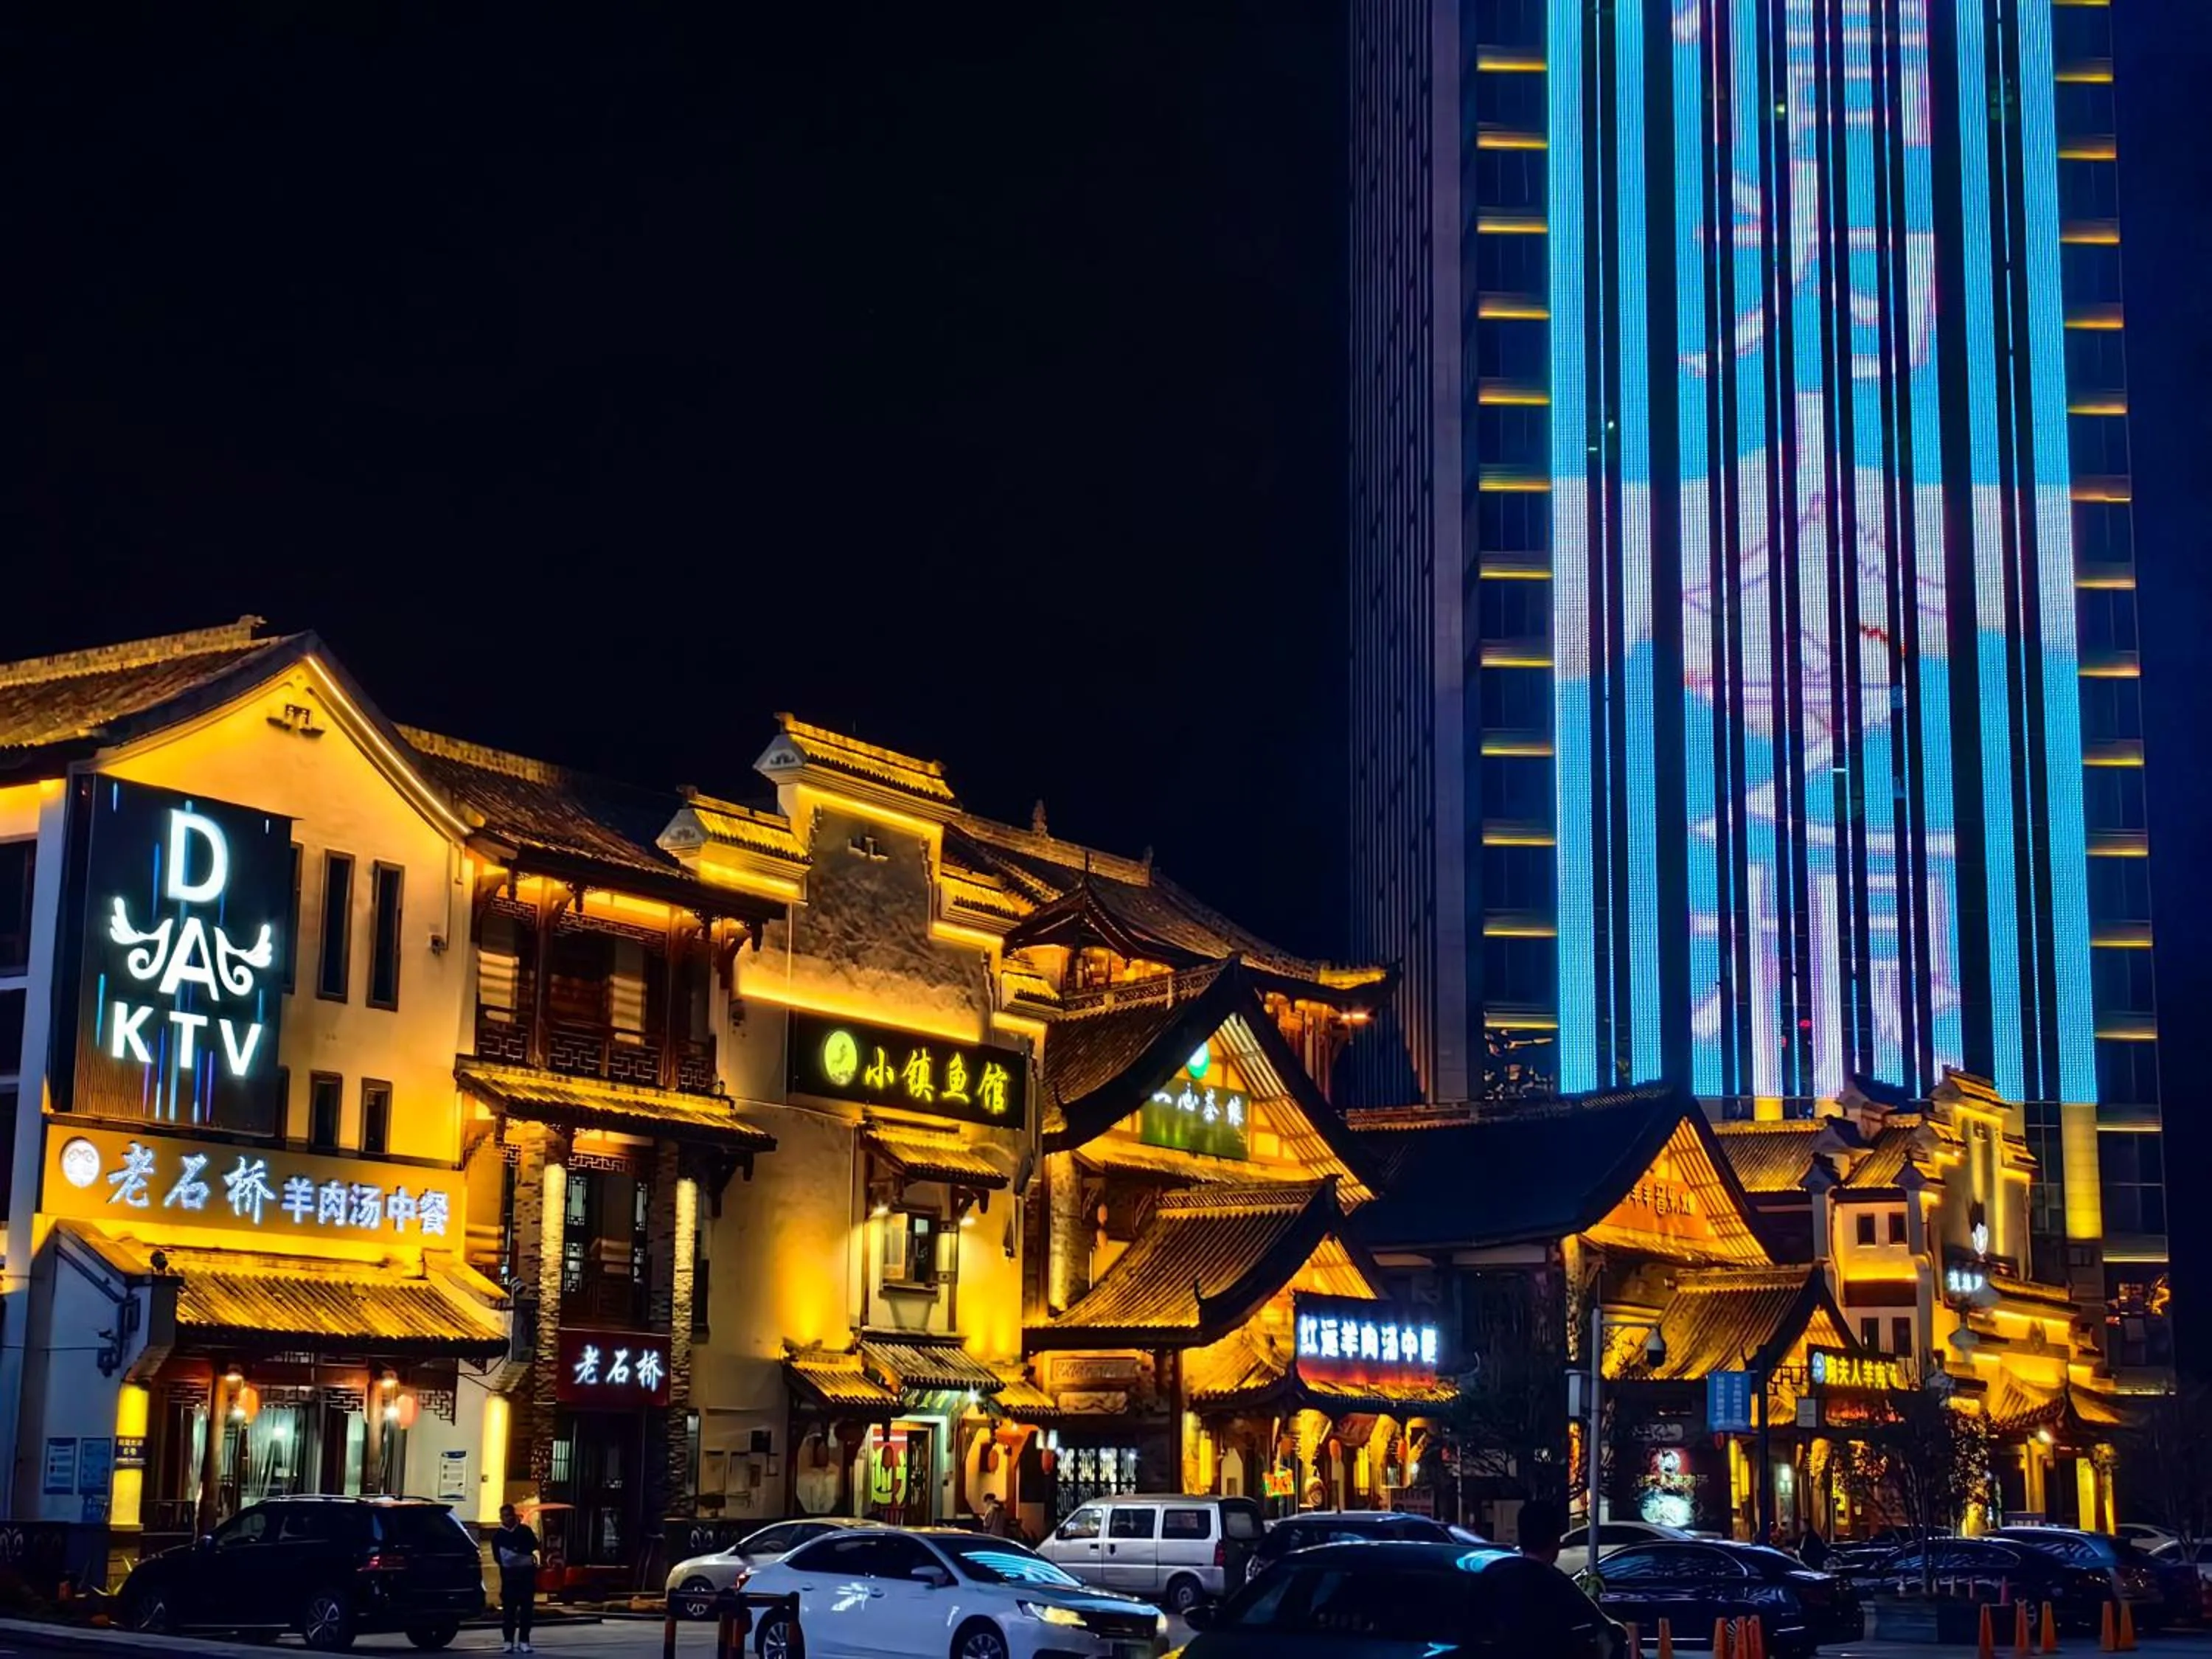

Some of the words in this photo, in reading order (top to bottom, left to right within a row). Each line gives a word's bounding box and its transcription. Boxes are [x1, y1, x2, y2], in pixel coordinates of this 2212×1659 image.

[167, 809, 229, 902] D
[111, 1000, 262, 1076] KTV
[864, 1046, 1009, 1114] 小镇鱼馆
[107, 1140, 276, 1224] 老石桥
[282, 1175, 449, 1237] 羊肉汤中餐
[573, 1344, 664, 1392] 老石桥
